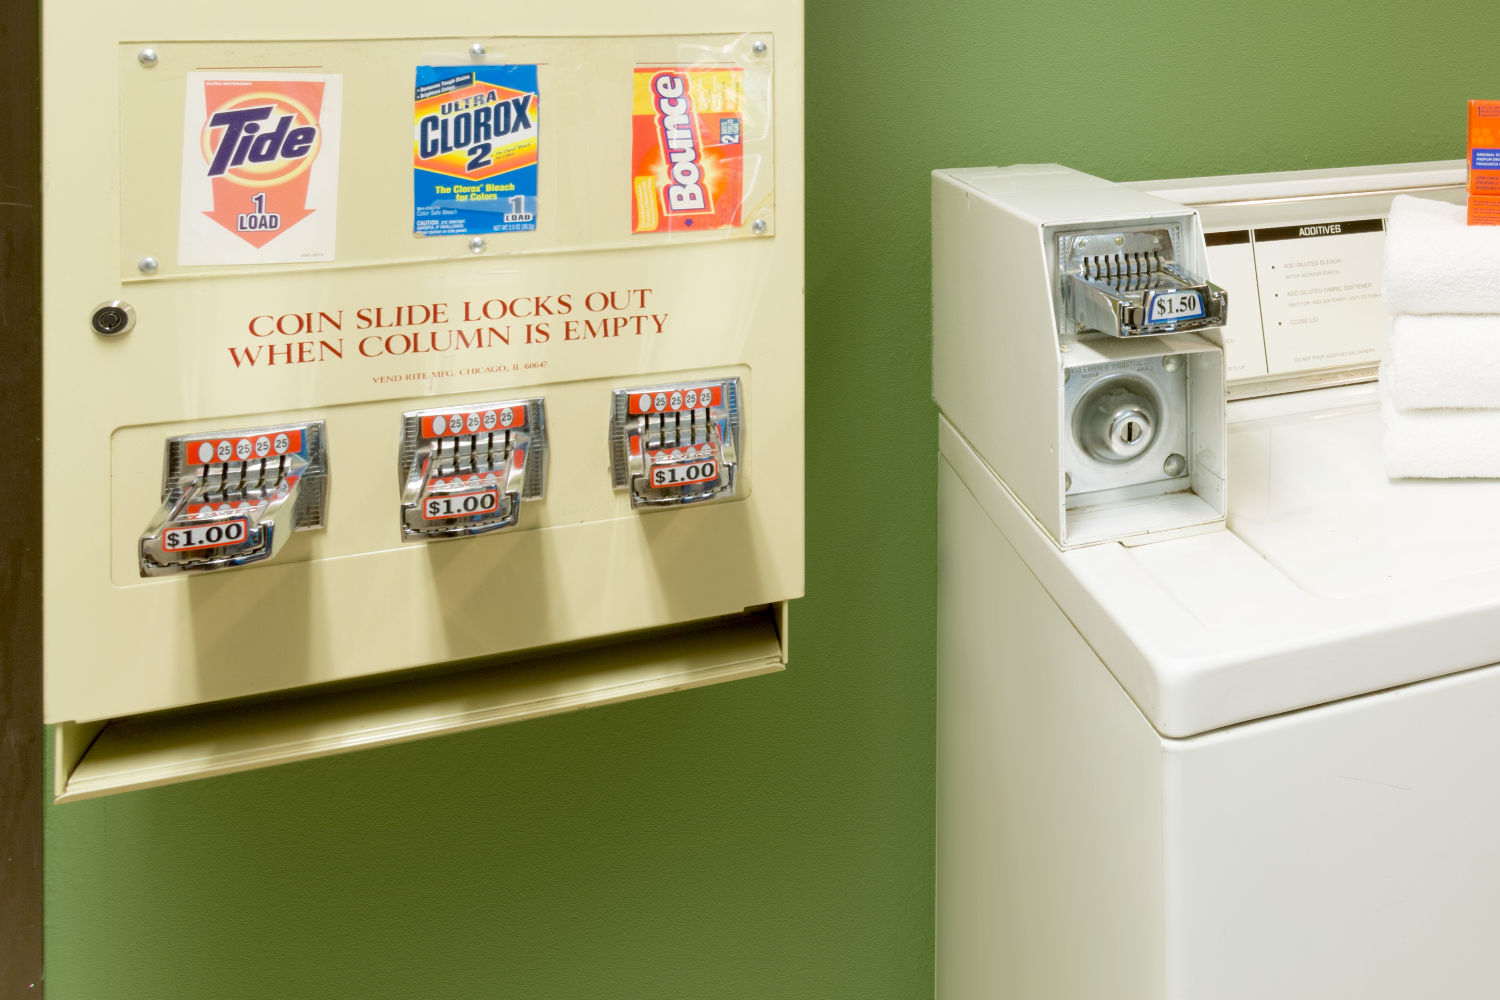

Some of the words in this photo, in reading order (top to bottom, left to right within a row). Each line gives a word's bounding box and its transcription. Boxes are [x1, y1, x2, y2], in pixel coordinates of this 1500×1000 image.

[441, 89, 498, 115] ULTRA
[420, 94, 532, 159] CLOROX
[207, 105, 317, 177] Tide
[655, 74, 706, 211] Bounce
[721, 134, 740, 144] 2
[466, 142, 492, 172] 2
[434, 185, 451, 194] The
[453, 184, 481, 193] Clorox
[485, 182, 515, 192] Bleach
[455, 193, 468, 201] for
[470, 192, 498, 201] Colors
[253, 194, 265, 214] 1
[508, 195, 524, 214] 1
[238, 213, 280, 231] LOAD
[505, 214, 531, 222] LOAD
[1299, 224, 1341, 236] ADDITIVES
[248, 310, 344, 337] COIN
[356, 302, 449, 330] SLIDE
[463, 294, 572, 322] LOCKS
[585, 288, 653, 312] OUT
[1156, 295, 1197, 316] $1.50
[228, 338, 344, 368] WHEN
[358, 325, 511, 358] COLUMN
[525, 322, 550, 344] IS
[563, 313, 670, 341] EMPTY
[372, 375, 403, 384] VEND
[405, 372, 428, 382] RITE
[431, 370, 455, 379] MFG.
[459, 365, 509, 377] CHICAGO,
[523, 360, 548, 370] 60647
[655, 398, 666, 407] 25
[671, 397, 682, 405] 25
[686, 395, 696, 403] 25
[701, 392, 711, 401] 25
[450, 418, 462, 428] 25
[468, 417, 479, 427] 25
[484, 415, 495, 424] 25
[501, 412, 512, 421] 25
[219, 446, 231, 456] 25
[238, 444, 250, 454] 25
[257, 441, 268, 451] 25
[276, 438, 288, 448] 25
[655, 463, 714, 484] $1.00
[428, 493, 495, 516] $1.00
[167, 523, 243, 548] $1.00
